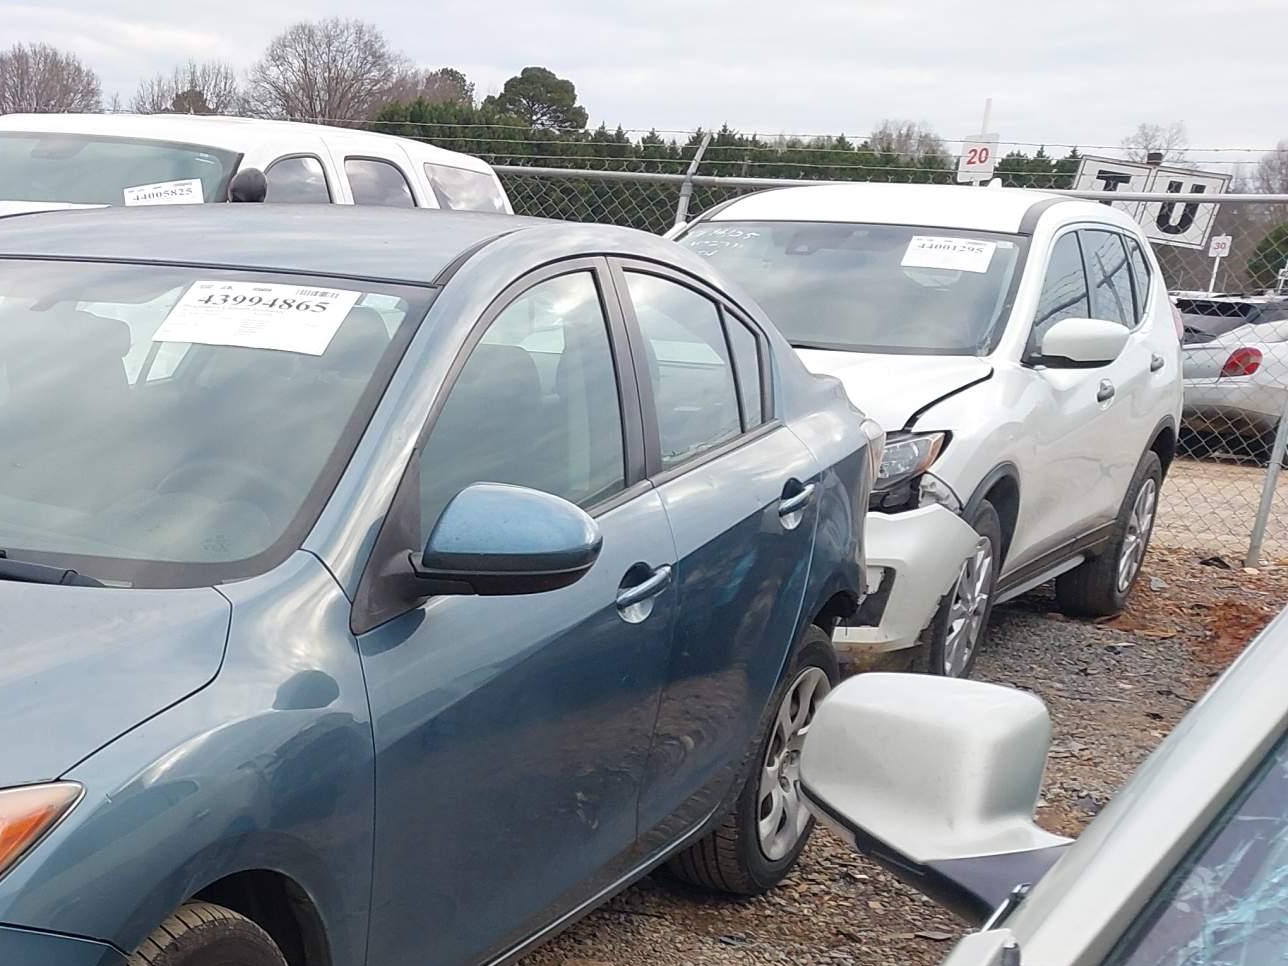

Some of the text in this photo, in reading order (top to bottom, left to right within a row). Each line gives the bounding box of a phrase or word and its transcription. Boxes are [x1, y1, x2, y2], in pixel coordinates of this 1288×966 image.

[966, 147, 990, 165] 20
[1155, 180, 1207, 235] U
[1213, 241, 1226, 251] 30
[197, 293, 330, 313] 43994865
